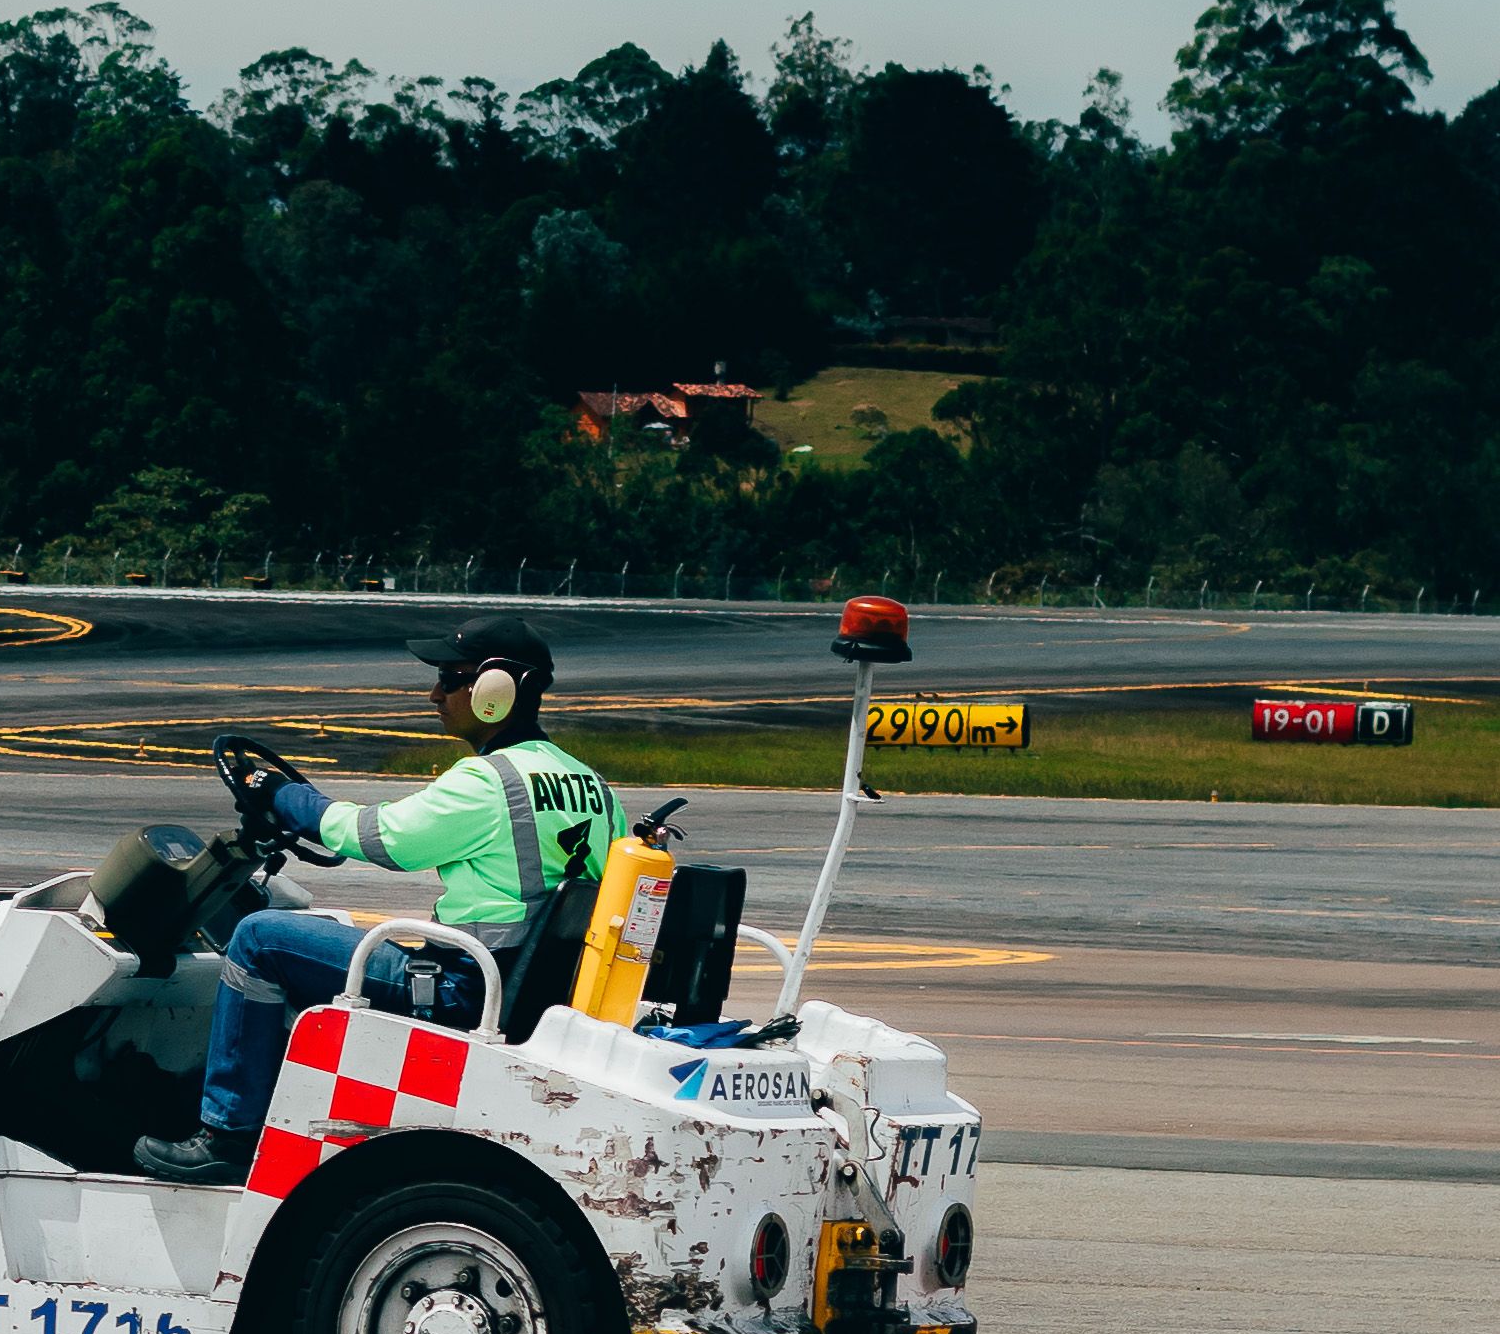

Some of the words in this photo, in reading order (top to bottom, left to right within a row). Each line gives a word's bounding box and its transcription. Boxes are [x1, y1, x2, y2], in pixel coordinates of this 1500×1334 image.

[867, 707, 964, 743] 2990
[971, 725, 997, 743] m
[1263, 708, 1335, 735] 19-01
[1373, 711, 1390, 735] D
[529, 772, 604, 815] AV175
[709, 1071, 811, 1101] AEROSAN
[900, 1125, 943, 1177] TT
